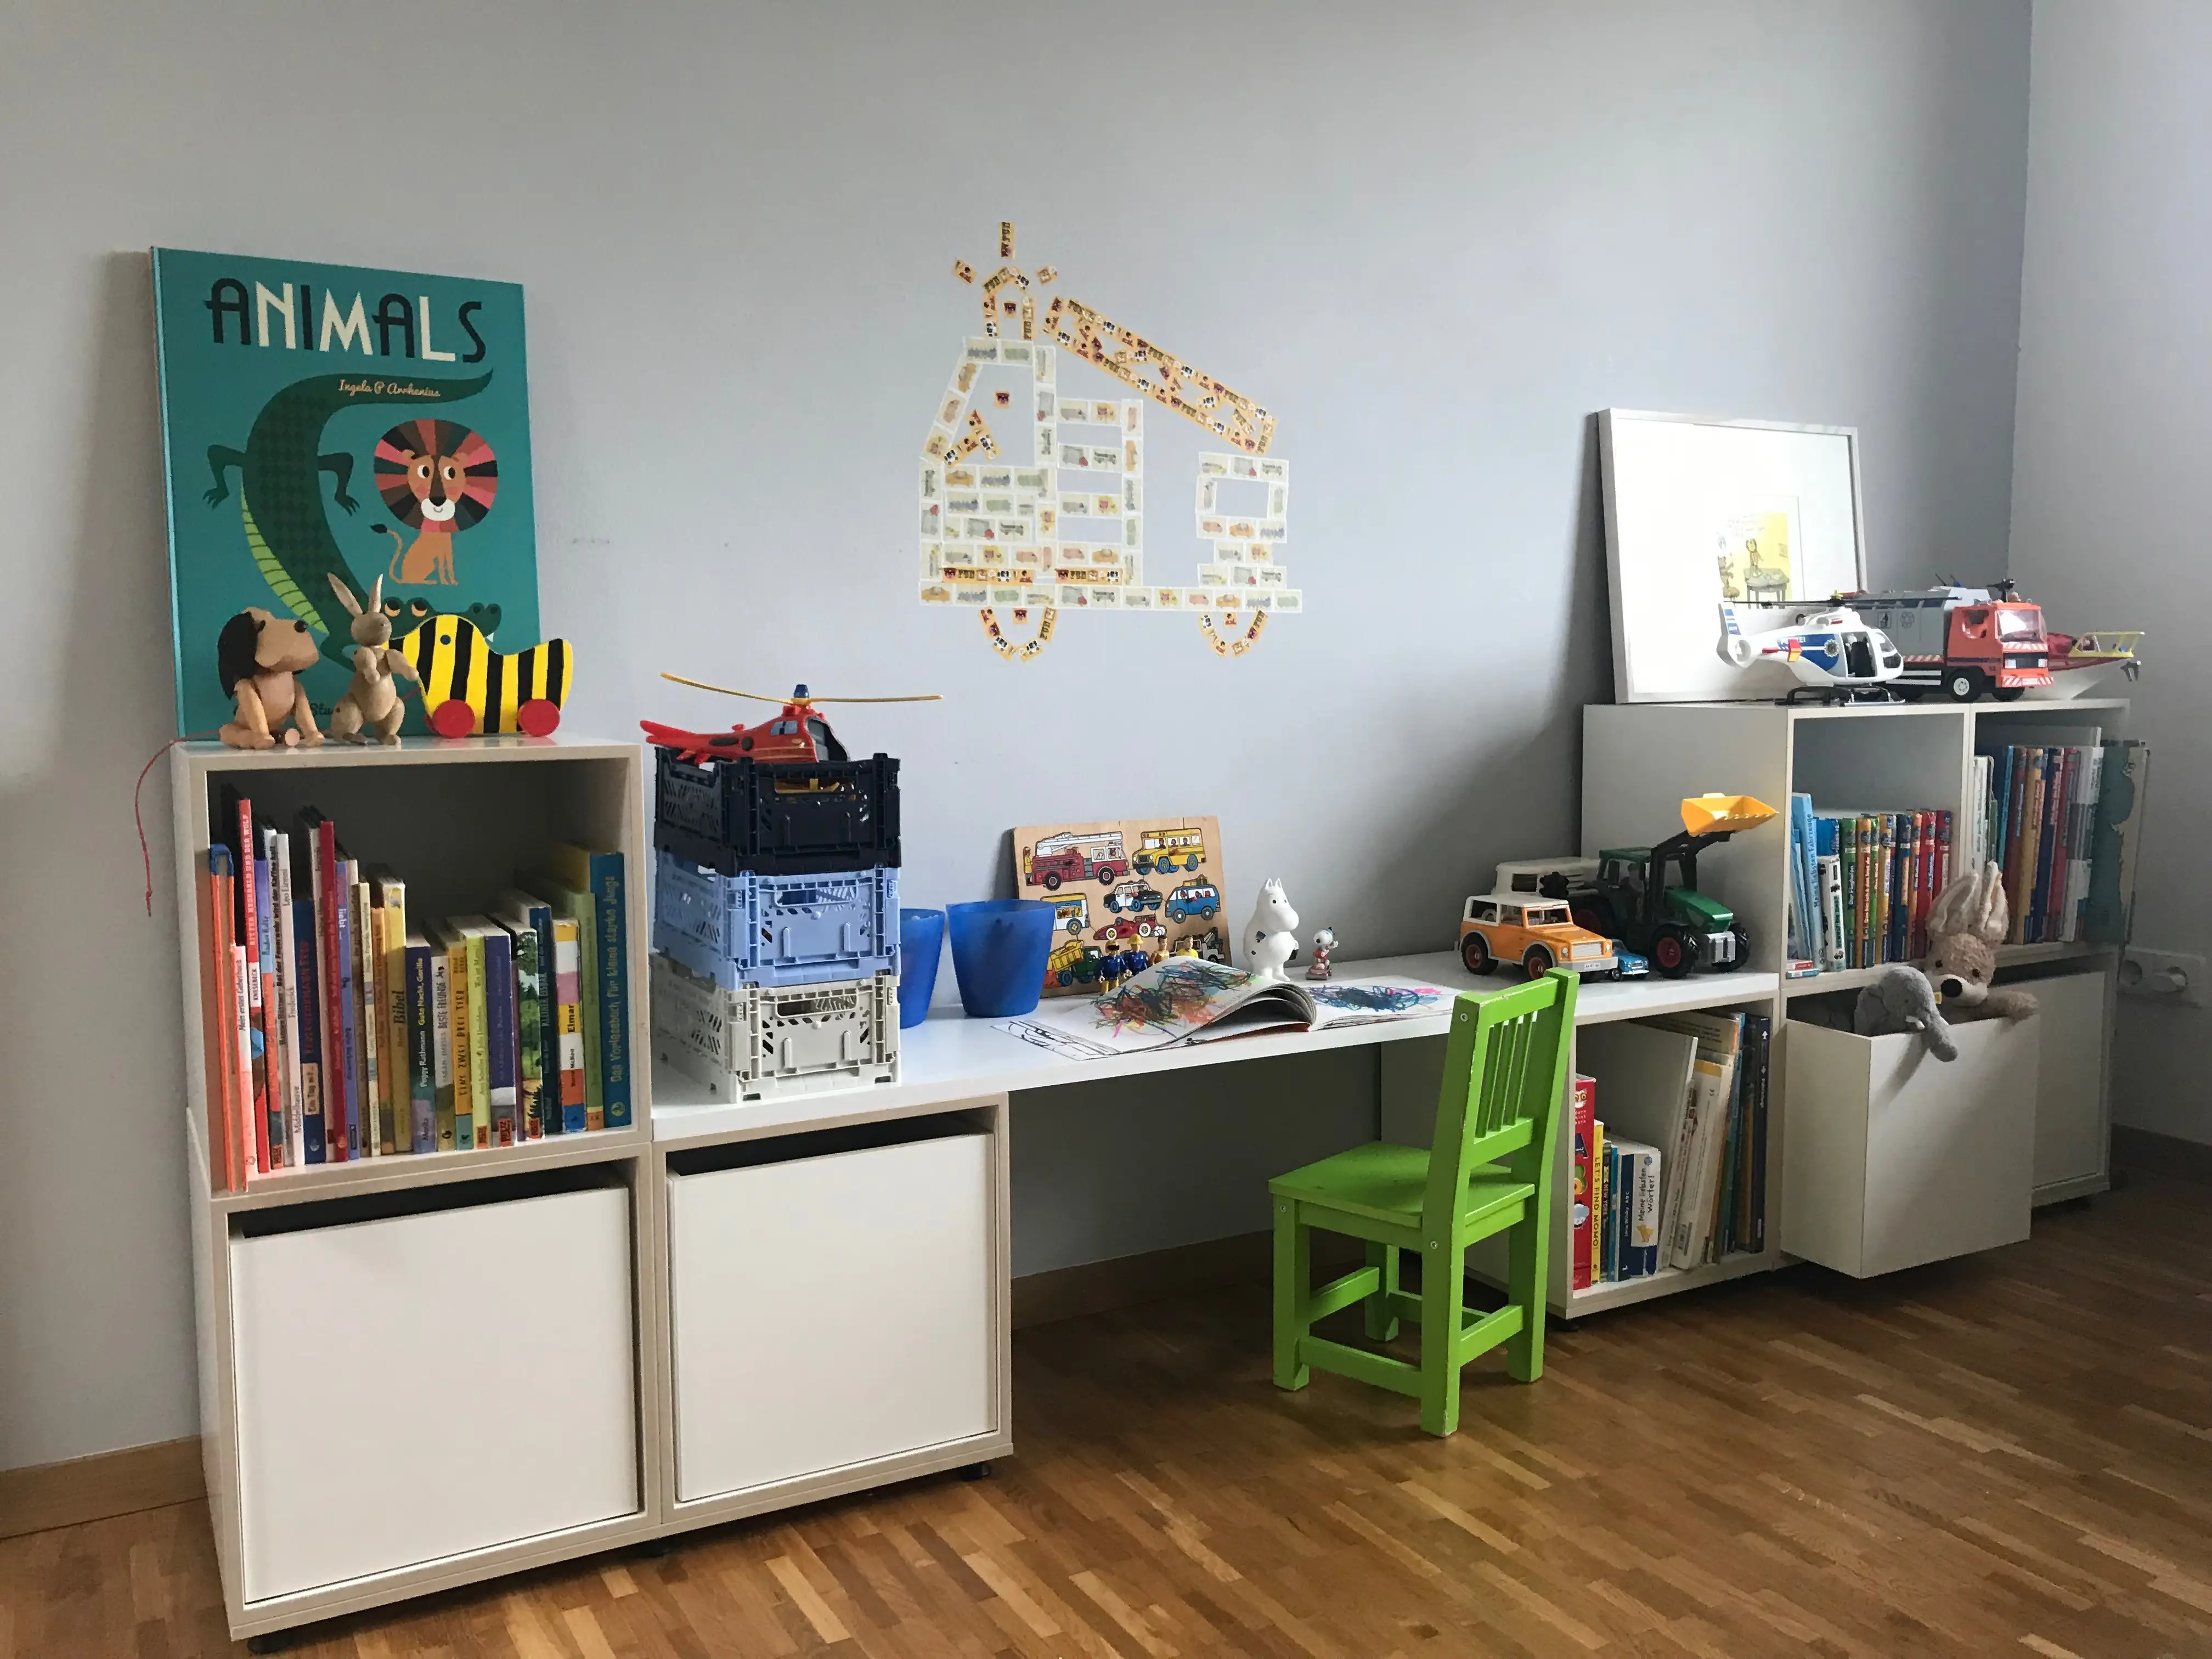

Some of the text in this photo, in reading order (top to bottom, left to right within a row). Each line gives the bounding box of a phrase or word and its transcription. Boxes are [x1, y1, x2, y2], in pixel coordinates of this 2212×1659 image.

[204, 276, 488, 363] ANIMALS
[338, 379, 373, 397] Ingela
[958, 569, 975, 579] FUN
[391, 990, 406, 1024] Bibel
[436, 981, 447, 1009] FREUNDE
[437, 1011, 448, 1029] BESTE
[566, 1005, 575, 1033] Elmar
[418, 1031, 427, 1065] Rathmann
[1638, 1199, 1646, 1222] Meine
